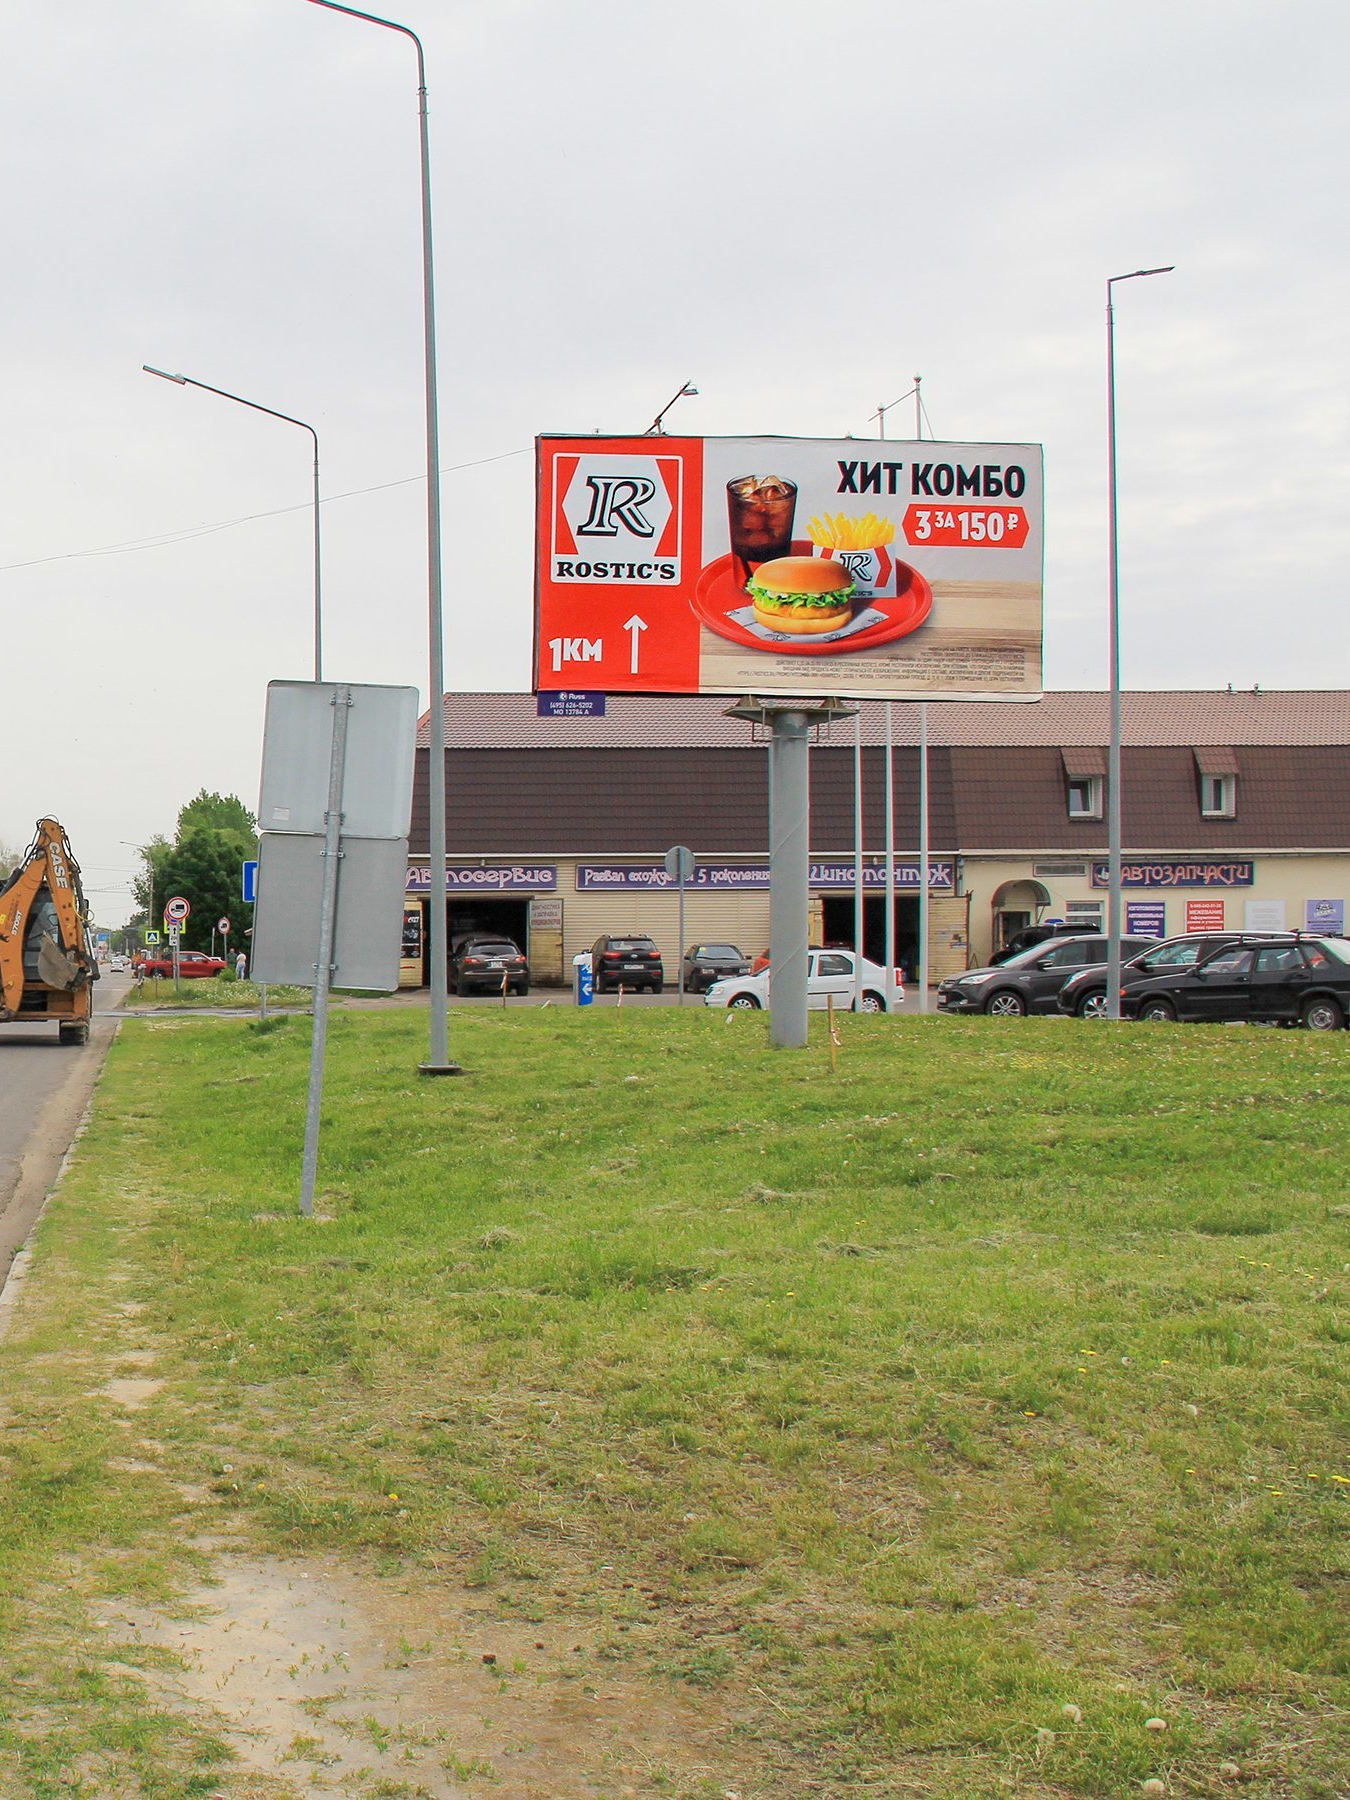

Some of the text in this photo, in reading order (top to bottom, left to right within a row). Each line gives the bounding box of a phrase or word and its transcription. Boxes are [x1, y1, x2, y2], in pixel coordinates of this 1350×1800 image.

[837, 461, 1025, 498] ХИТ КОМБО
[915, 511, 931, 540] 3
[556, 561, 676, 579] ROSTIC'S
[50, 841, 69, 889] CASE
[697, 869, 707, 883] 5
[1120, 864, 1249, 885] АВТОЗАПЧАСТИ
